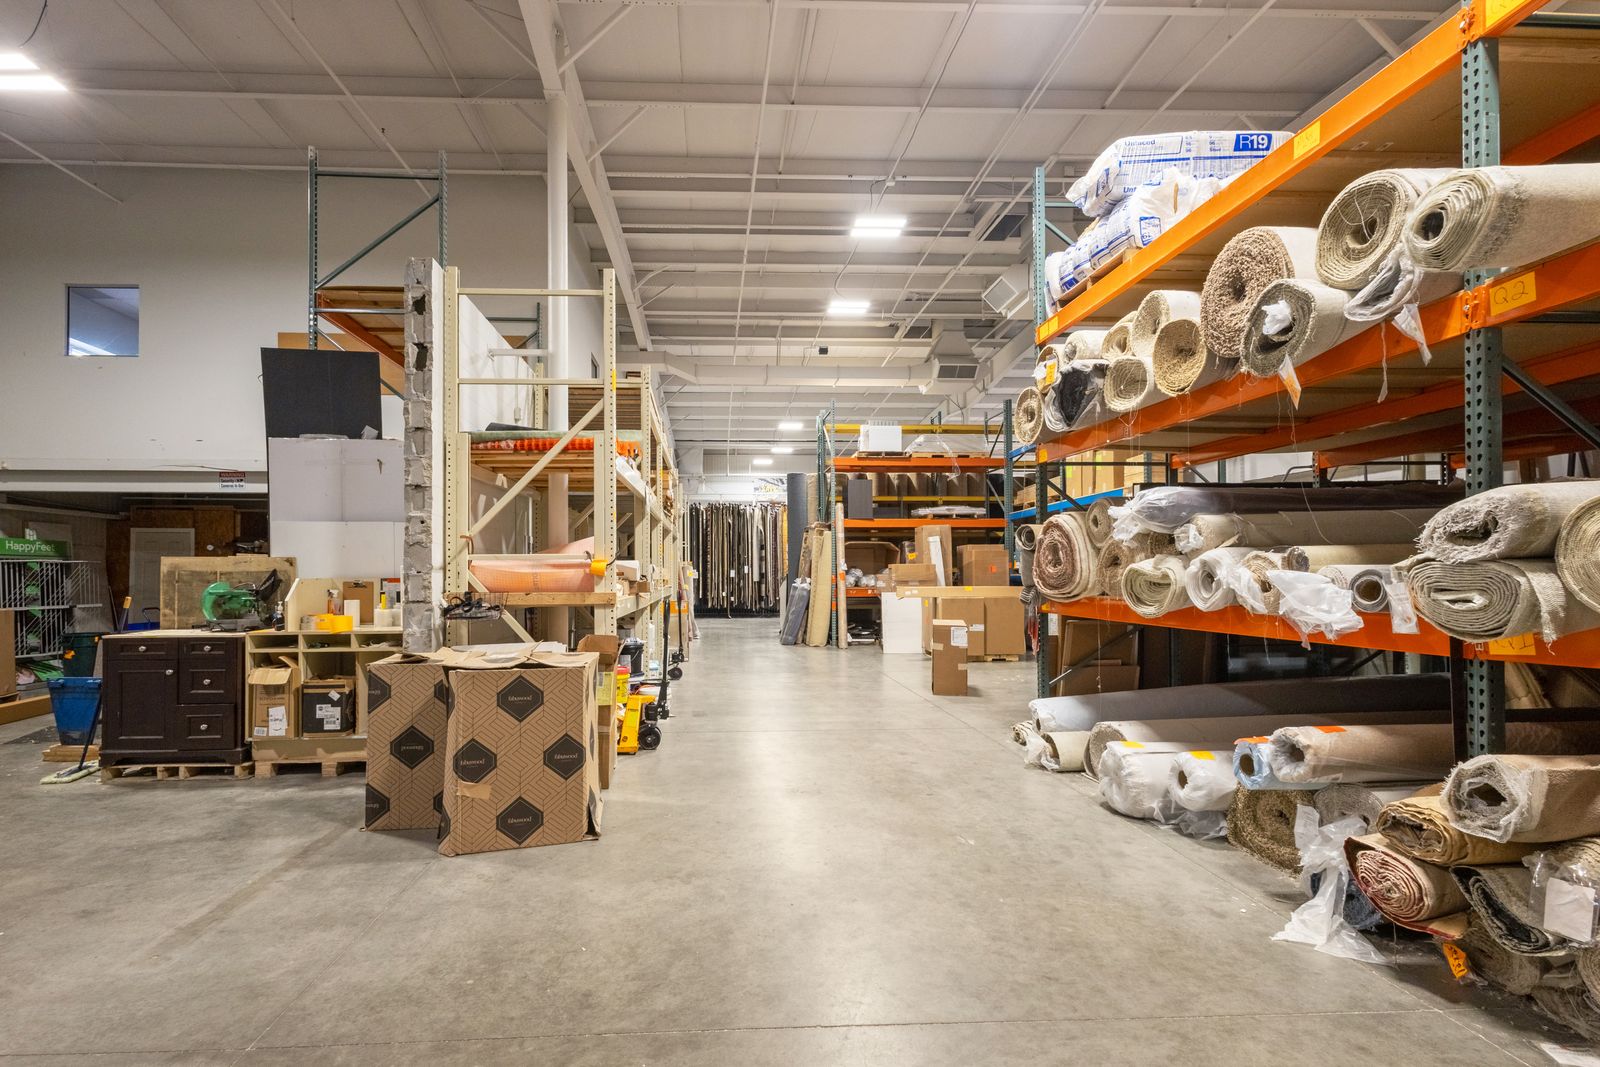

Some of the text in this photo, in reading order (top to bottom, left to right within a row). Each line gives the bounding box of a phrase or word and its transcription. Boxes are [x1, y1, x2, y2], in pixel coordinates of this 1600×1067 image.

[1240, 134, 1268, 149] R19
[1494, 280, 1528, 304] Q2
[5, 541, 55, 553] HappyFeet
